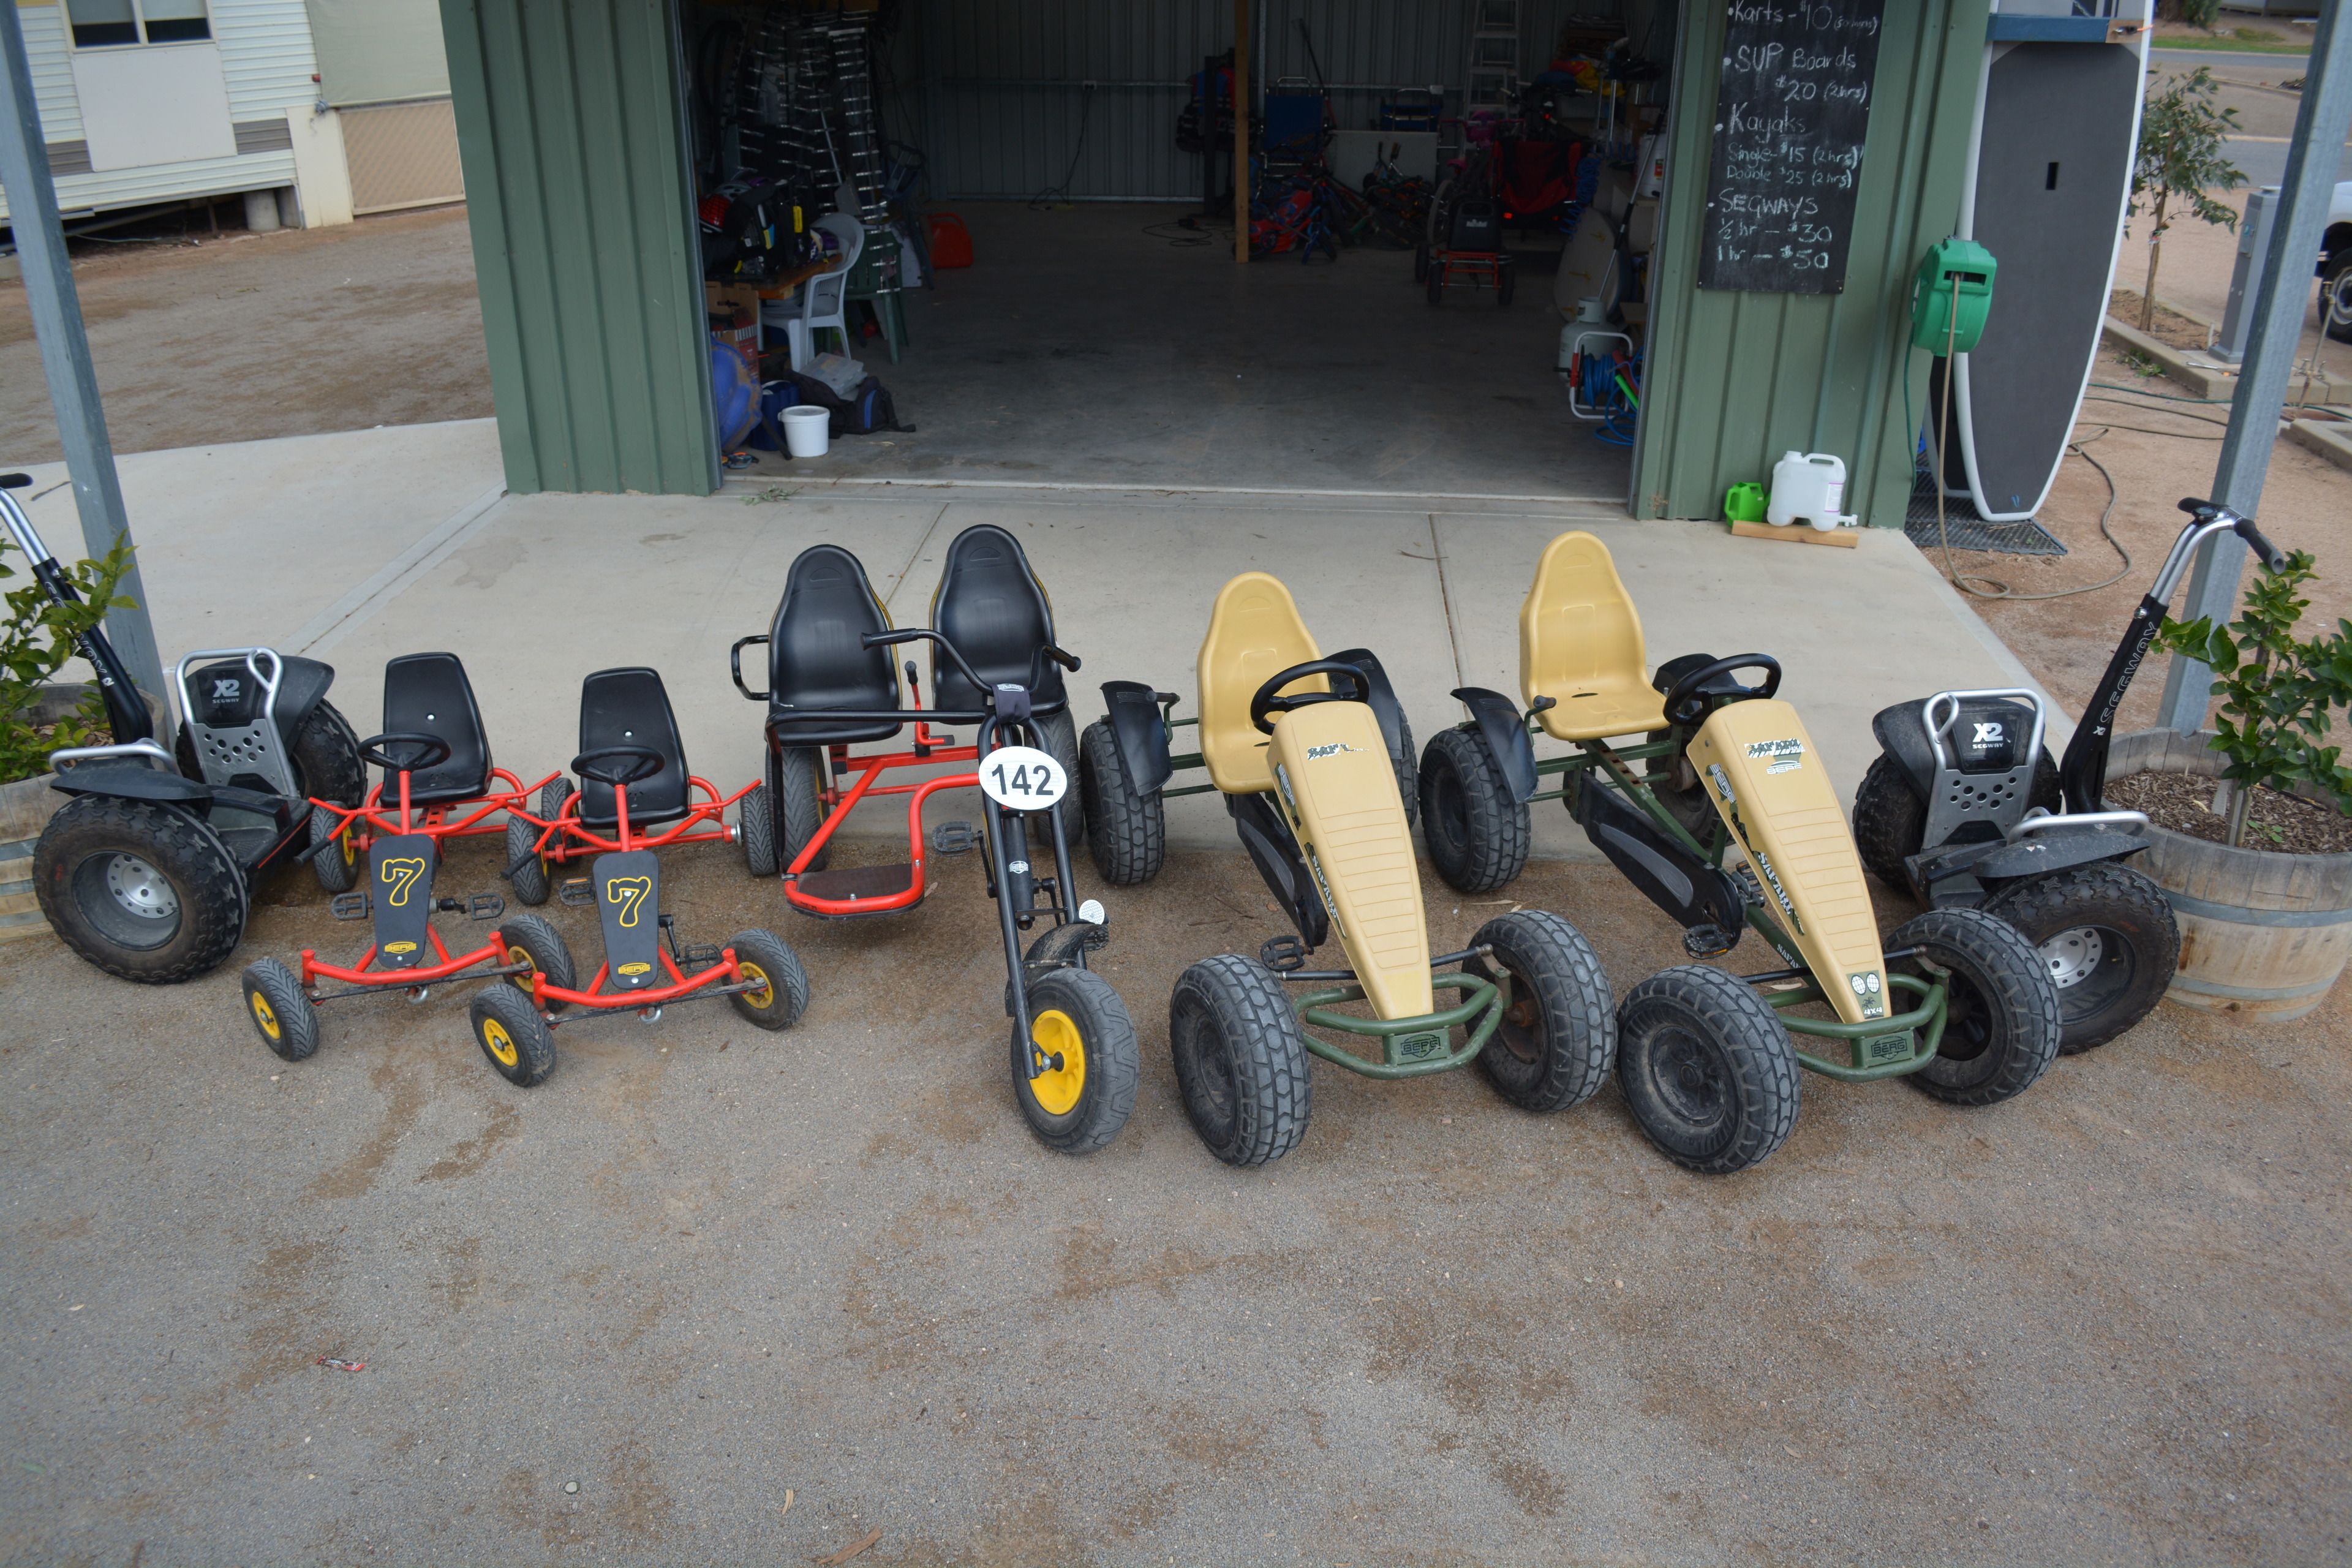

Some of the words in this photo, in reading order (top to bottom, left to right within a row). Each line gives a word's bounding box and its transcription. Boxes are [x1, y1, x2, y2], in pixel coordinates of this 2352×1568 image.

[1735, 42, 1784, 72] SUP
[1792, 46, 1856, 70] Boards
[1776, 74, 1817, 102] $20
[1729, 102, 1806, 143] Kayaks
[1781, 141, 1806, 163] $15
[1727, 165, 1771, 182] Double
[1779, 166, 1806, 184] $25
[1719, 187, 1819, 219] SEGWAYS
[1788, 221, 1832, 243] $30
[1780, 244, 1829, 269] $50
[2100, 621, 2158, 724] SEGWAY
[213, 679, 240, 698] X2
[1972, 722, 2003, 742] X2
[2093, 726, 2106, 736] X2
[992, 764, 1054, 796] 142
[382, 858, 425, 907] 7
[1758, 852, 1793, 914] SAFARI
[608, 876, 652, 927] 7
[1864, 1006, 1882, 1015] 4X4
[1873, 1042, 1905, 1054] BERG
